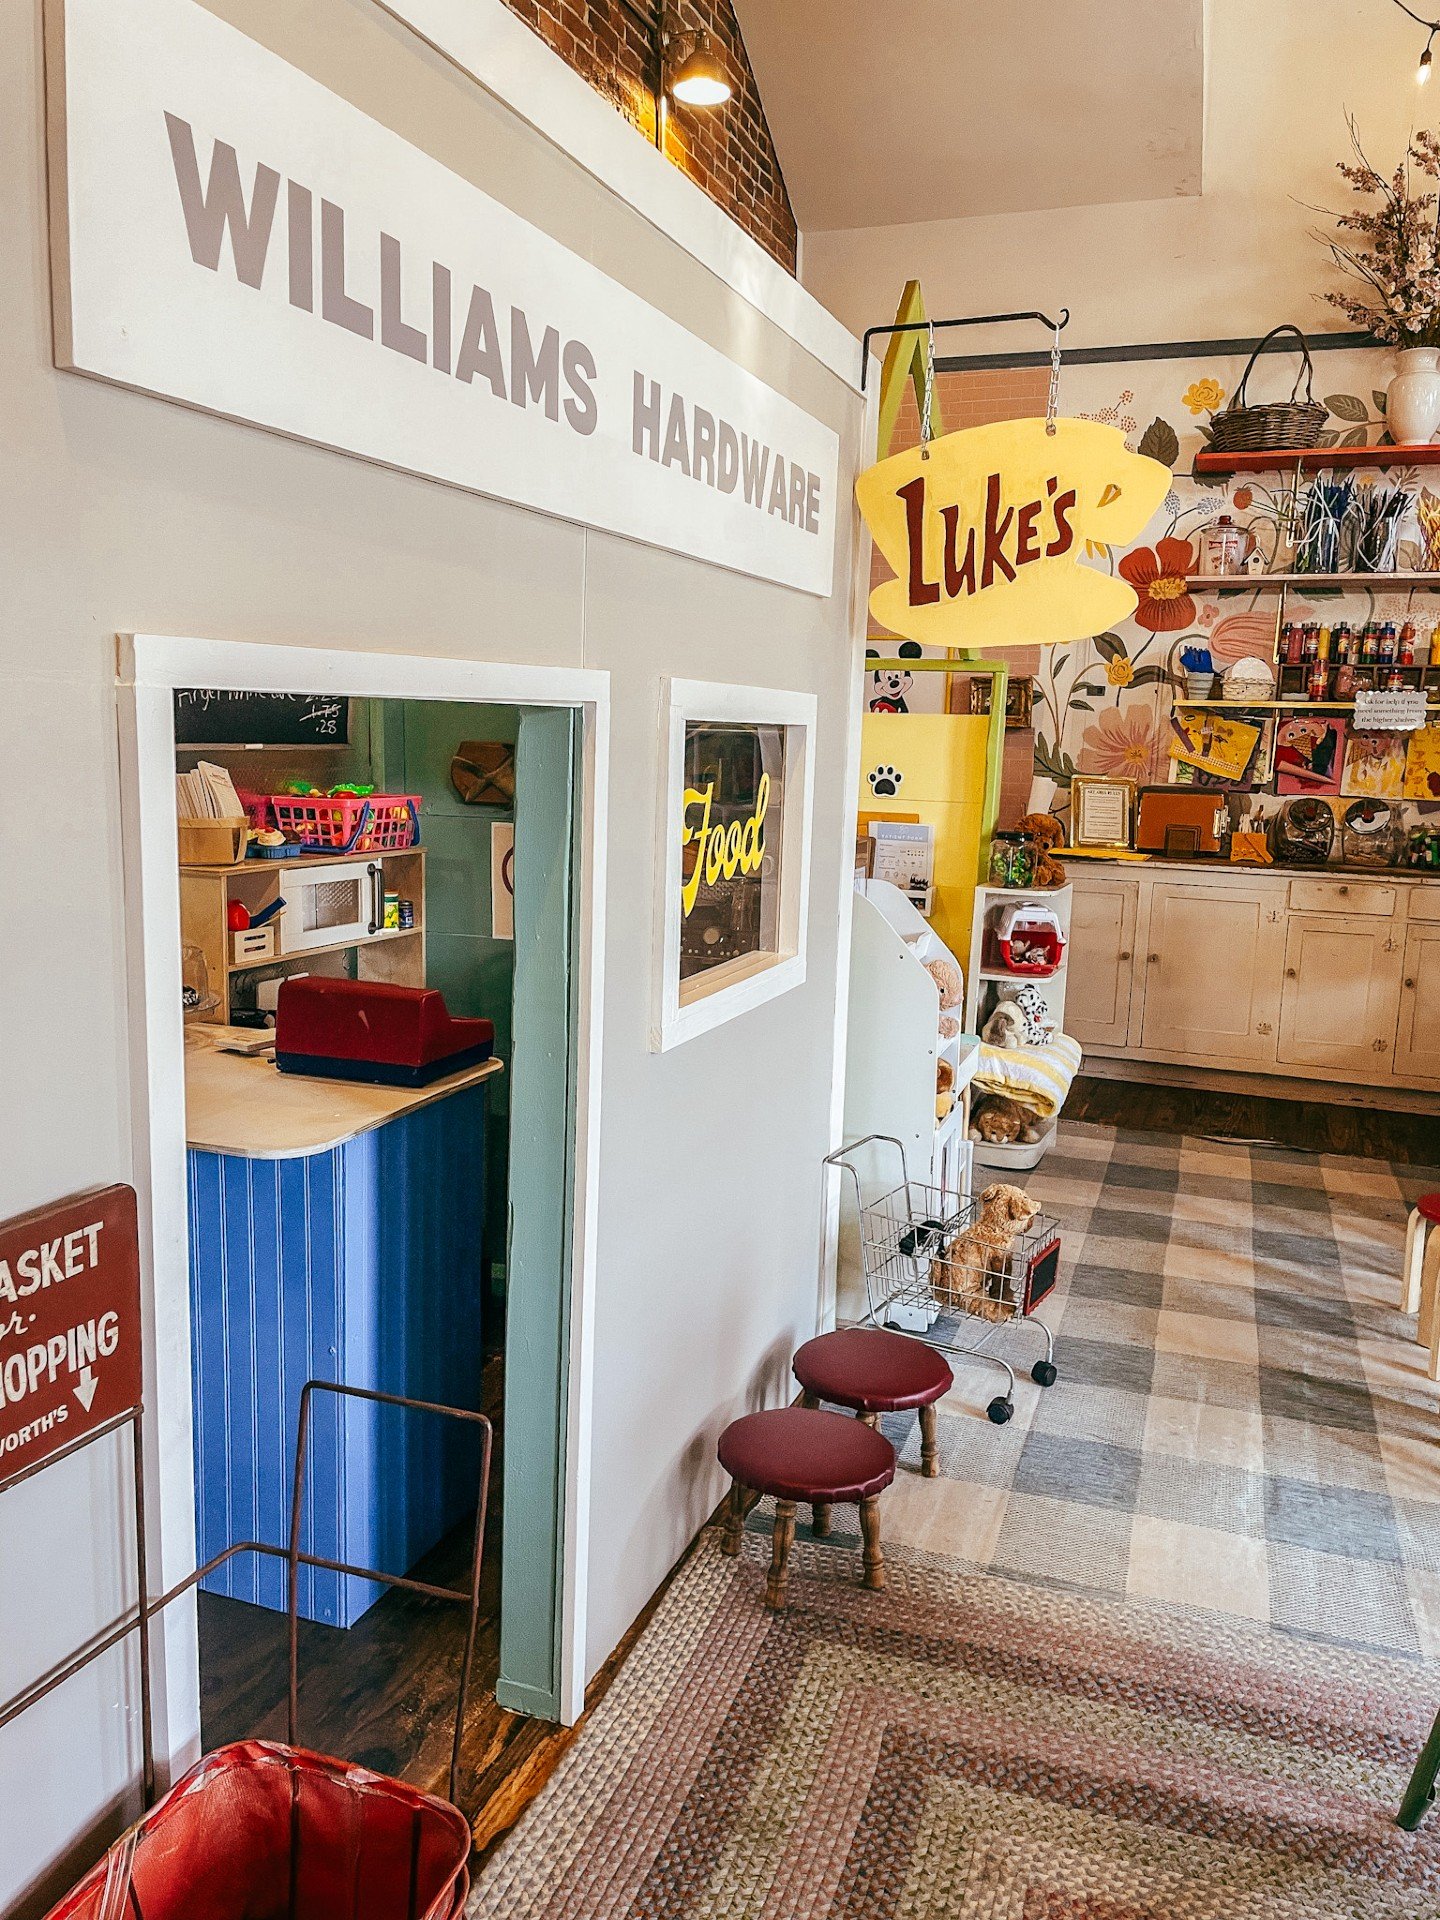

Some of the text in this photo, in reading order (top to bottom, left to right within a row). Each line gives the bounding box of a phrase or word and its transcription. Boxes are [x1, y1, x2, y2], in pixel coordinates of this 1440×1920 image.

[164, 110, 822, 535] WILLIAMS HARDWARE
[681, 772, 770, 918] Food
